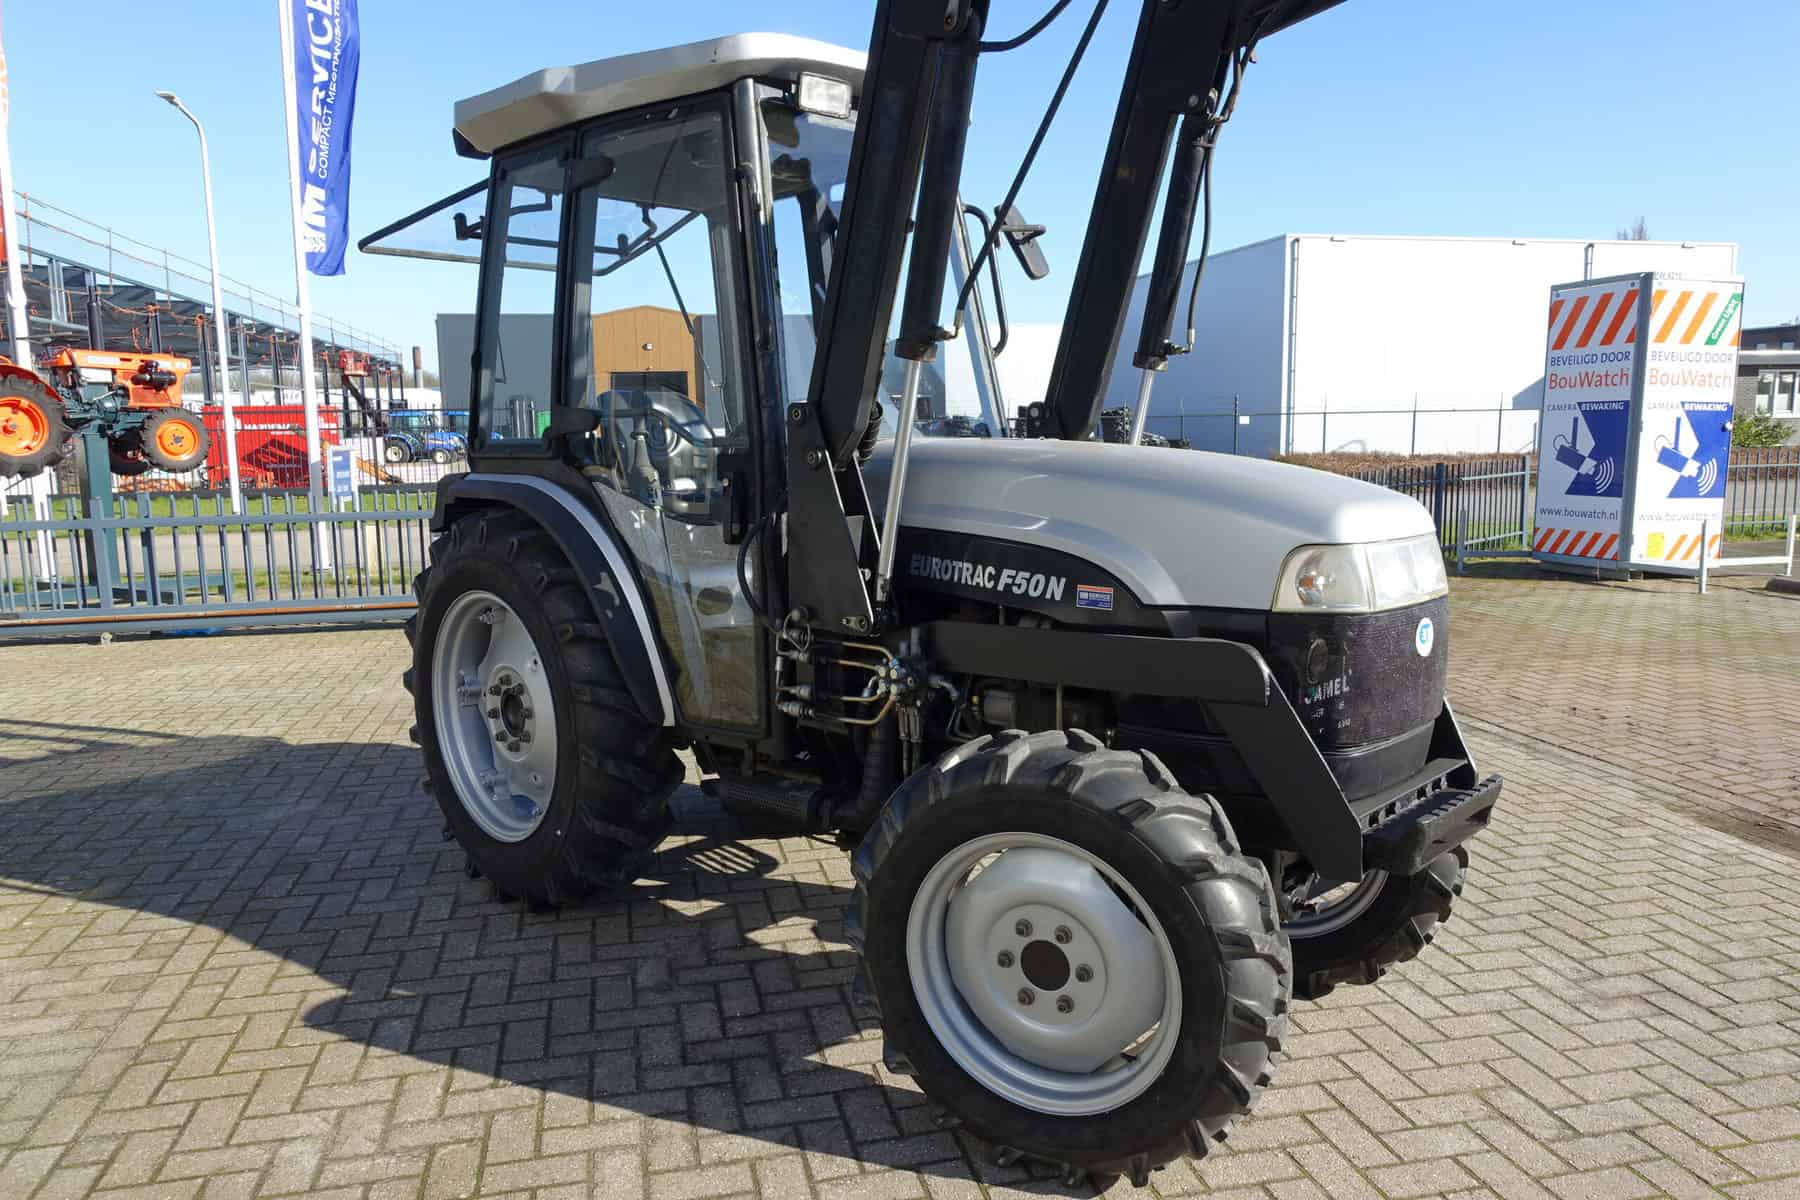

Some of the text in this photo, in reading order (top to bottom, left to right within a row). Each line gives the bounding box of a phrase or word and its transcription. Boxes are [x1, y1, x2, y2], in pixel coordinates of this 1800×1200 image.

[318, 105, 333, 179] COMPACT
[1551, 351, 1631, 366] BEVEILIGD DOOR
[1549, 368, 1629, 389] BouWatch
[1649, 367, 1732, 388] BouWatch
[1581, 402, 1624, 411] BEWAKING
[1540, 506, 1618, 520] www.bouwatch.nl
[910, 553, 996, 589] EUROTRAC
